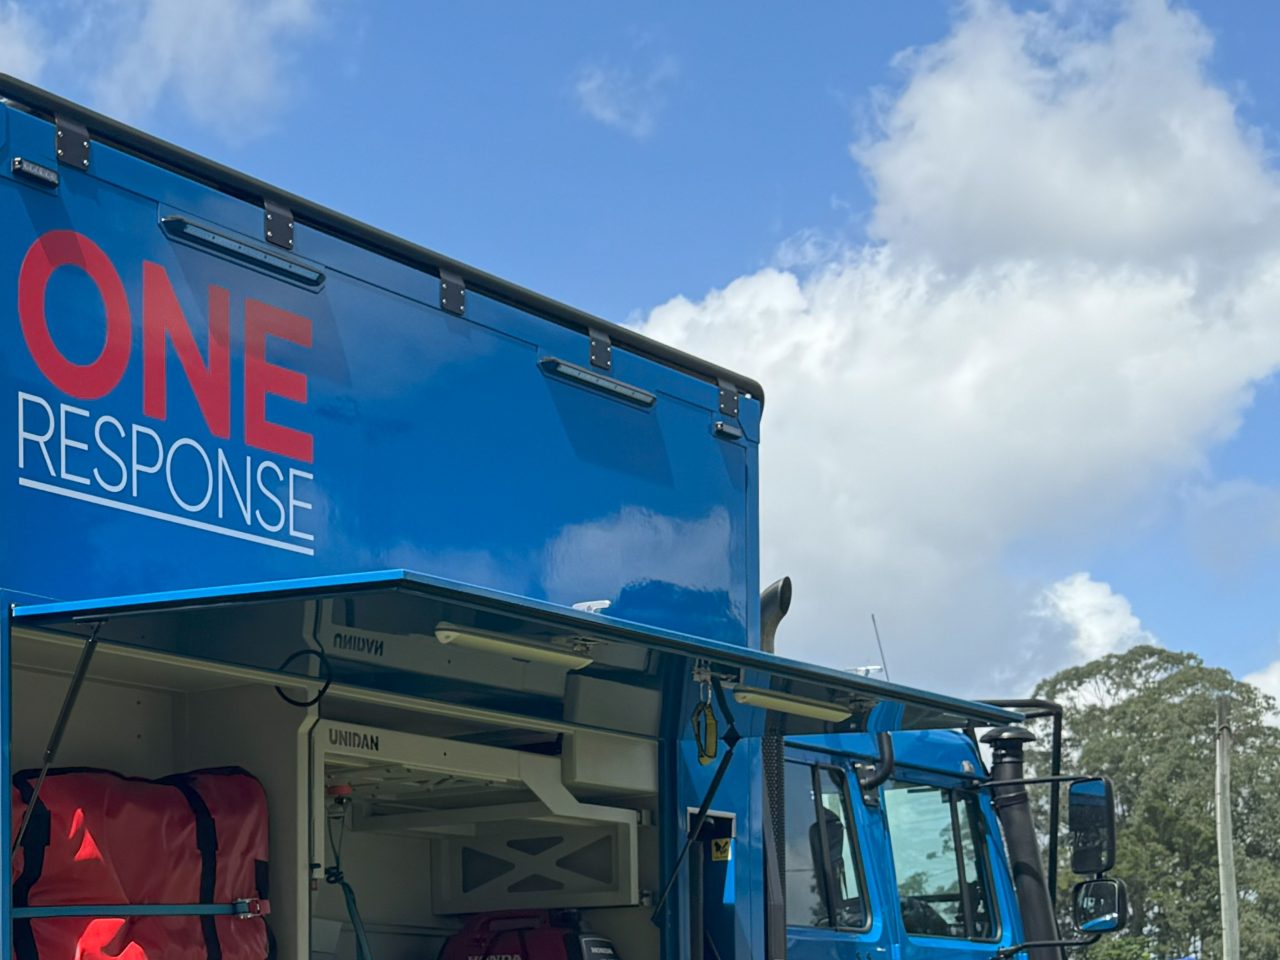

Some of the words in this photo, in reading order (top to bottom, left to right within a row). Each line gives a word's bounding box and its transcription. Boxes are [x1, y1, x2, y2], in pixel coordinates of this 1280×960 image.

[18, 229, 314, 464] ONE
[17, 390, 315, 541] RESPONSE
[329, 727, 379, 752] UNIDAN
